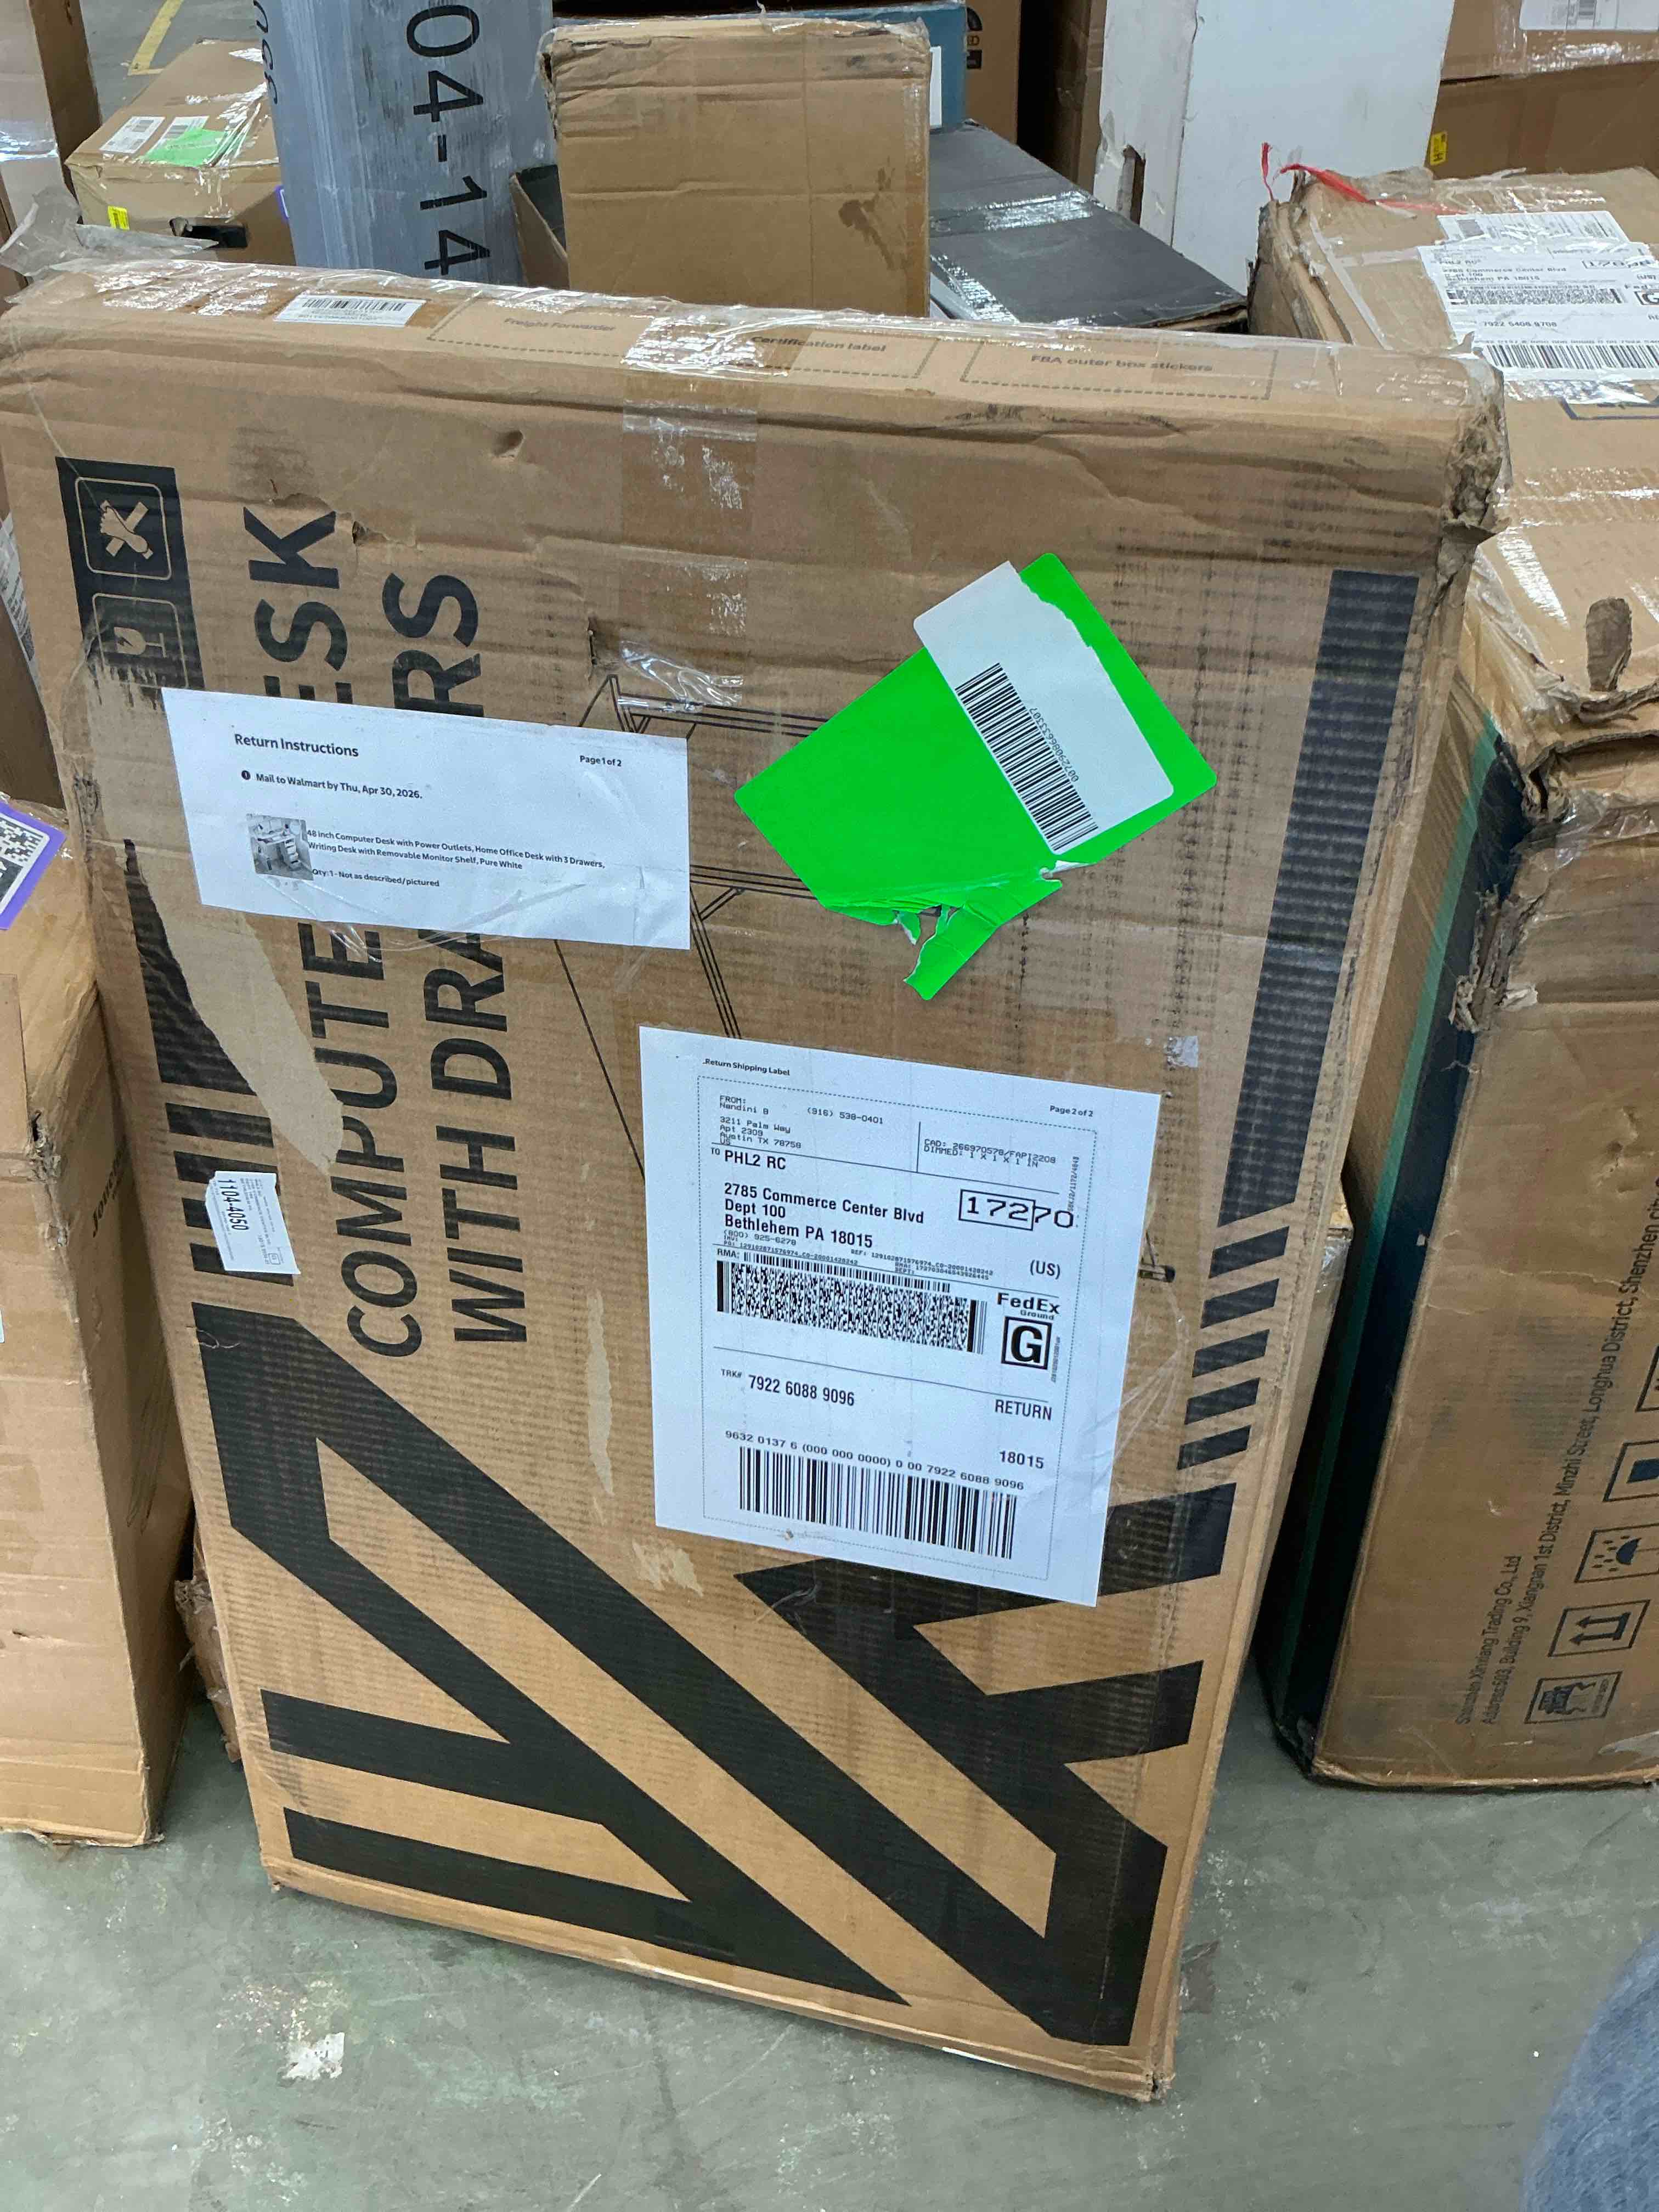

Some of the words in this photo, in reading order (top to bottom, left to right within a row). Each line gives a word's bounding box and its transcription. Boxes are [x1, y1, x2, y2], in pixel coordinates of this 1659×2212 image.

[847, 341, 887, 353] label
[1030, 354, 1063, 365] FBA
[1067, 358, 1113, 367] outer
[1115, 360, 1147, 369] box
[1150, 362, 1213, 373] stickers
[234, 733, 279, 748] Return
[280, 737, 359, 757] Instructions
[579, 755, 601, 765] Page
[256, 773, 275, 783] Mail
[276, 775, 286, 784] to
[287, 776, 326, 789] Walmart
[327, 781, 338, 792] by
[340, 782, 360, 794] Thu,
[362, 785, 378, 795] Apr
[380, 787, 395, 797] 30,
[396, 788, 422, 799] 2026.
[307, 829, 317, 837] 48
[318, 831, 334, 839] inch
[335, 833, 374, 844] Computer
[376, 837, 395, 845] Desk
[396, 839, 414, 847] with
[415, 840, 440, 850] Power
[441, 843, 474, 853] Outlets,
[475, 845, 499, 855] Home
[499, 848, 524, 858] Office
[524, 851, 544, 861] Desk
[545, 854, 563, 863] with
[569, 857, 605, 869] Drawers,
[308, 842, 336, 853] Writing
[338, 845, 357, 854] Desk
[358, 847, 375, 855] with
[376, 849, 421, 860] Removable
[422, 853, 454, 863] Monitor
[455, 856, 479, 865] Shelf,
[480, 858, 498, 867] Pure
[499, 860, 523, 870] White
[364, 873, 439, 887] described/pictured
[705, 1058, 732, 1068] Return
[732, 1062, 768, 1075] Shipping
[769, 1066, 791, 1076] Label
[720, 1102, 757, 1114] Nandini
[720, 1095, 746, 1104] FROM:
[807, 1107, 833, 1118] (916)
[839, 1111, 883, 1125] 538-0401
[1049, 1105, 1071, 1115] Page
[1078, 1108, 1087, 1116] of
[720, 1116, 741, 1125] 3211
[747, 1119, 769, 1130] Palm
[774, 1124, 791, 1134] Way
[720, 1125, 735, 1133] Apt
[742, 1127, 763, 1136] 2309
[298, 922, 422, 1357] COMPUTE
[758, 1136, 769, 1145] TX
[774, 1139, 802, 1149] 78758
[924, 1138, 946, 1148] CAD:
[710, 1147, 720, 1156] TO
[725, 1150, 760, 1167] PHL2
[768, 1156, 786, 1170] RC
[218, 1179, 249, 1231] 1104-4050
[724, 1182, 757, 1199] 2785
[763, 1187, 837, 1210] Commerce
[843, 1199, 888, 1218] Center
[894, 1207, 924, 1224] Blvd
[725, 1198, 755, 1216] Dept
[763, 1204, 786, 1219] 100
[436, 1125, 527, 1344] WITH
[724, 1229, 748, 1239] (800)
[725, 1214, 799, 1238] Bethlehem
[806, 1226, 825, 1241] PA
[831, 1229, 873, 1248] 18015
[717, 1248, 740, 1259] RMA:
[1618, 1222, 1658, 1295] Shenzhen
[1030, 1260, 1060, 1280] (US)
[997, 1292, 1060, 1314] FedEx
[1020, 1309, 1054, 1321] Ground
[1600, 1296, 1638, 1352] District,
[1011, 1325, 1043, 1363] G
[748, 1374, 780, 1393] 7922
[785, 1381, 817, 1400] 6088
[822, 1387, 855, 1406] 9096
[1583, 1353, 1617, 1412] Longhua
[994, 1398, 1053, 1421] RETURN
[1566, 1414, 1600, 1457] Street,
[725, 1430, 753, 1443] 9632
[757, 1435, 786, 1448] 0137
[791, 1441, 798, 1450] 6
[802, 1442, 827, 1456] (000
[832, 1449, 854, 1460] 000
[857, 1452, 891, 1468] 0000)
[895, 1459, 903, 1469] 0
[907, 1462, 922, 1472] 00
[927, 1464, 956, 1478] 7922
[960, 1471, 989, 1485] 6088
[994, 1477, 1024, 1491] 9096
[999, 1449, 1045, 1470] 18015
[1553, 1458, 1581, 1496] Minzhi
[1538, 1498, 1571, 1543] District,
[1482, 1597, 1512, 1637] Trading
